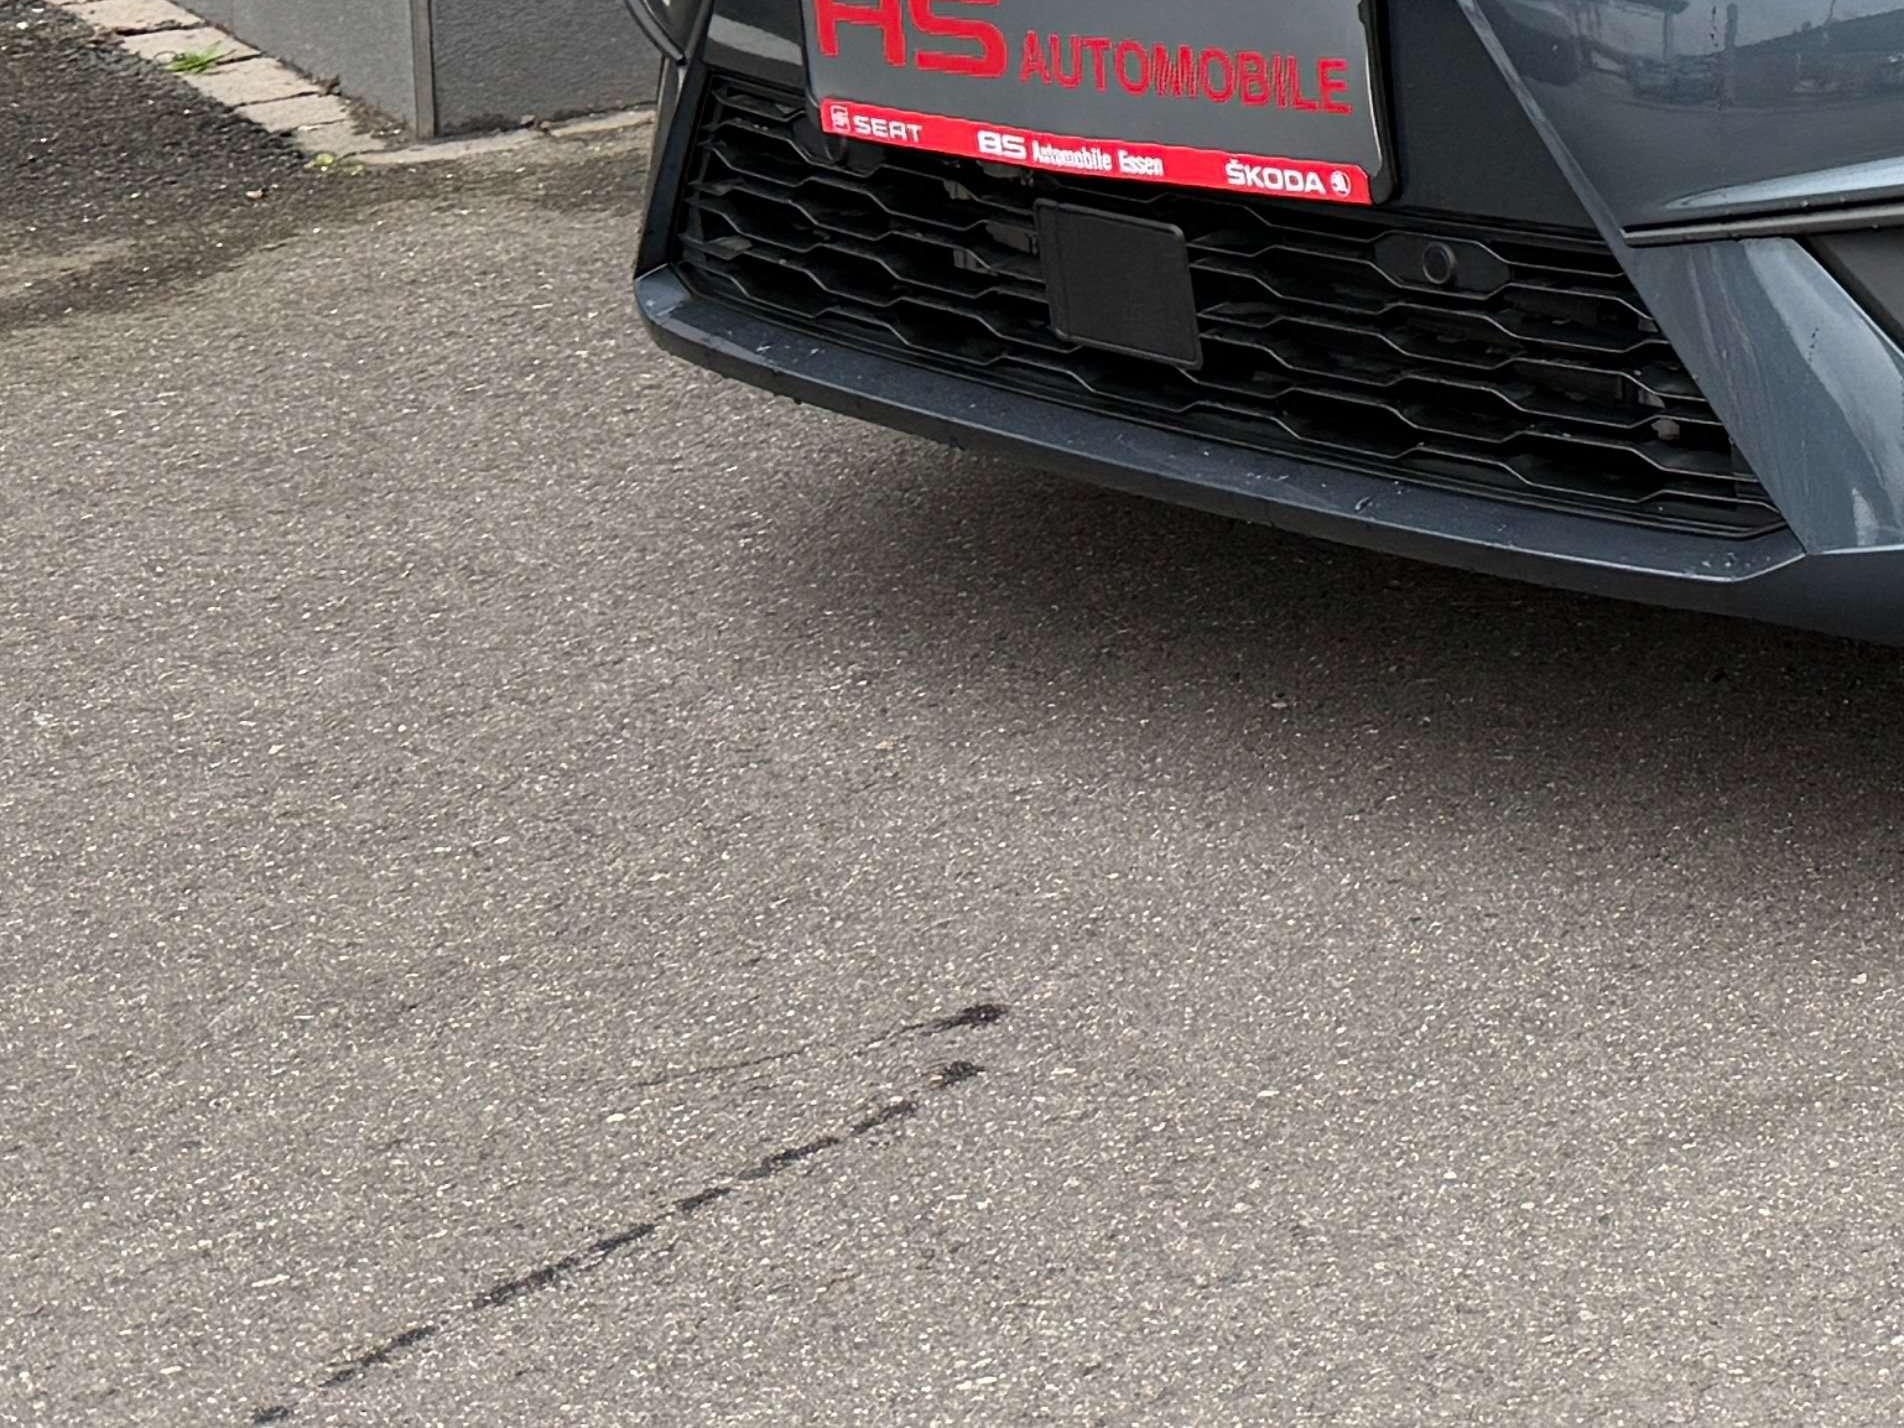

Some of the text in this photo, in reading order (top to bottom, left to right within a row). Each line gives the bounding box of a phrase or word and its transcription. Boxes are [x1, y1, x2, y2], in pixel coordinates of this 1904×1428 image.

[1019, 30, 1353, 114] AUTOMOBILE
[853, 115, 923, 142] SEAT
[1033, 140, 1112, 172] Automobile
[1118, 150, 1164, 177] Essen
[1225, 157, 1326, 194] ŠKODA
